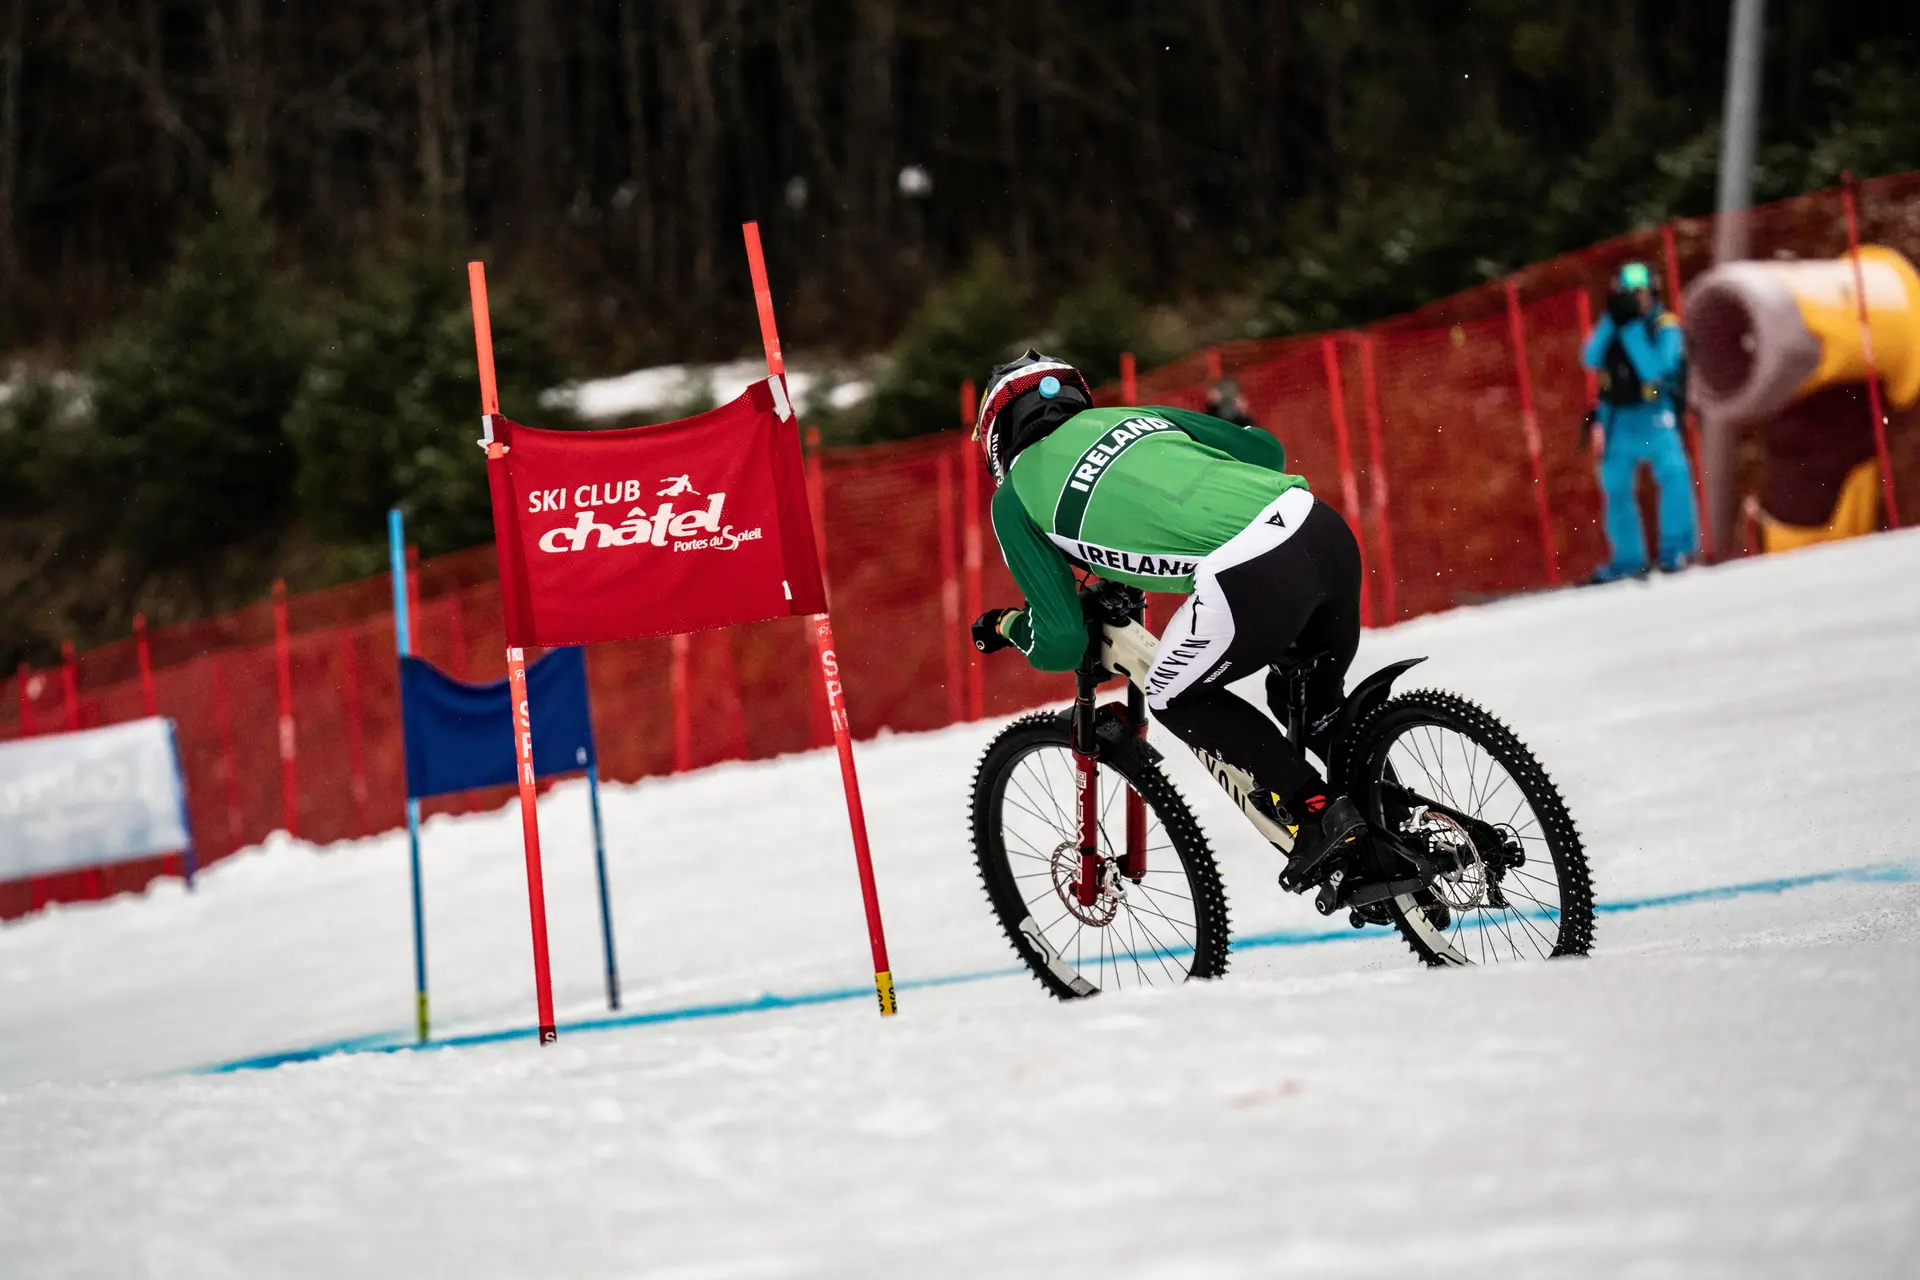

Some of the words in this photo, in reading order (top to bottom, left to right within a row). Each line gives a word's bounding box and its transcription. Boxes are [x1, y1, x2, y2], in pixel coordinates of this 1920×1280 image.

[1070, 417, 1170, 493] IRELAND
[528, 488, 566, 513] SKI
[574, 479, 641, 506] CLUB
[538, 492, 726, 553] châtel
[673, 538, 709, 552] Portes
[709, 535, 724, 547] du
[713, 525, 763, 550] Soleil
